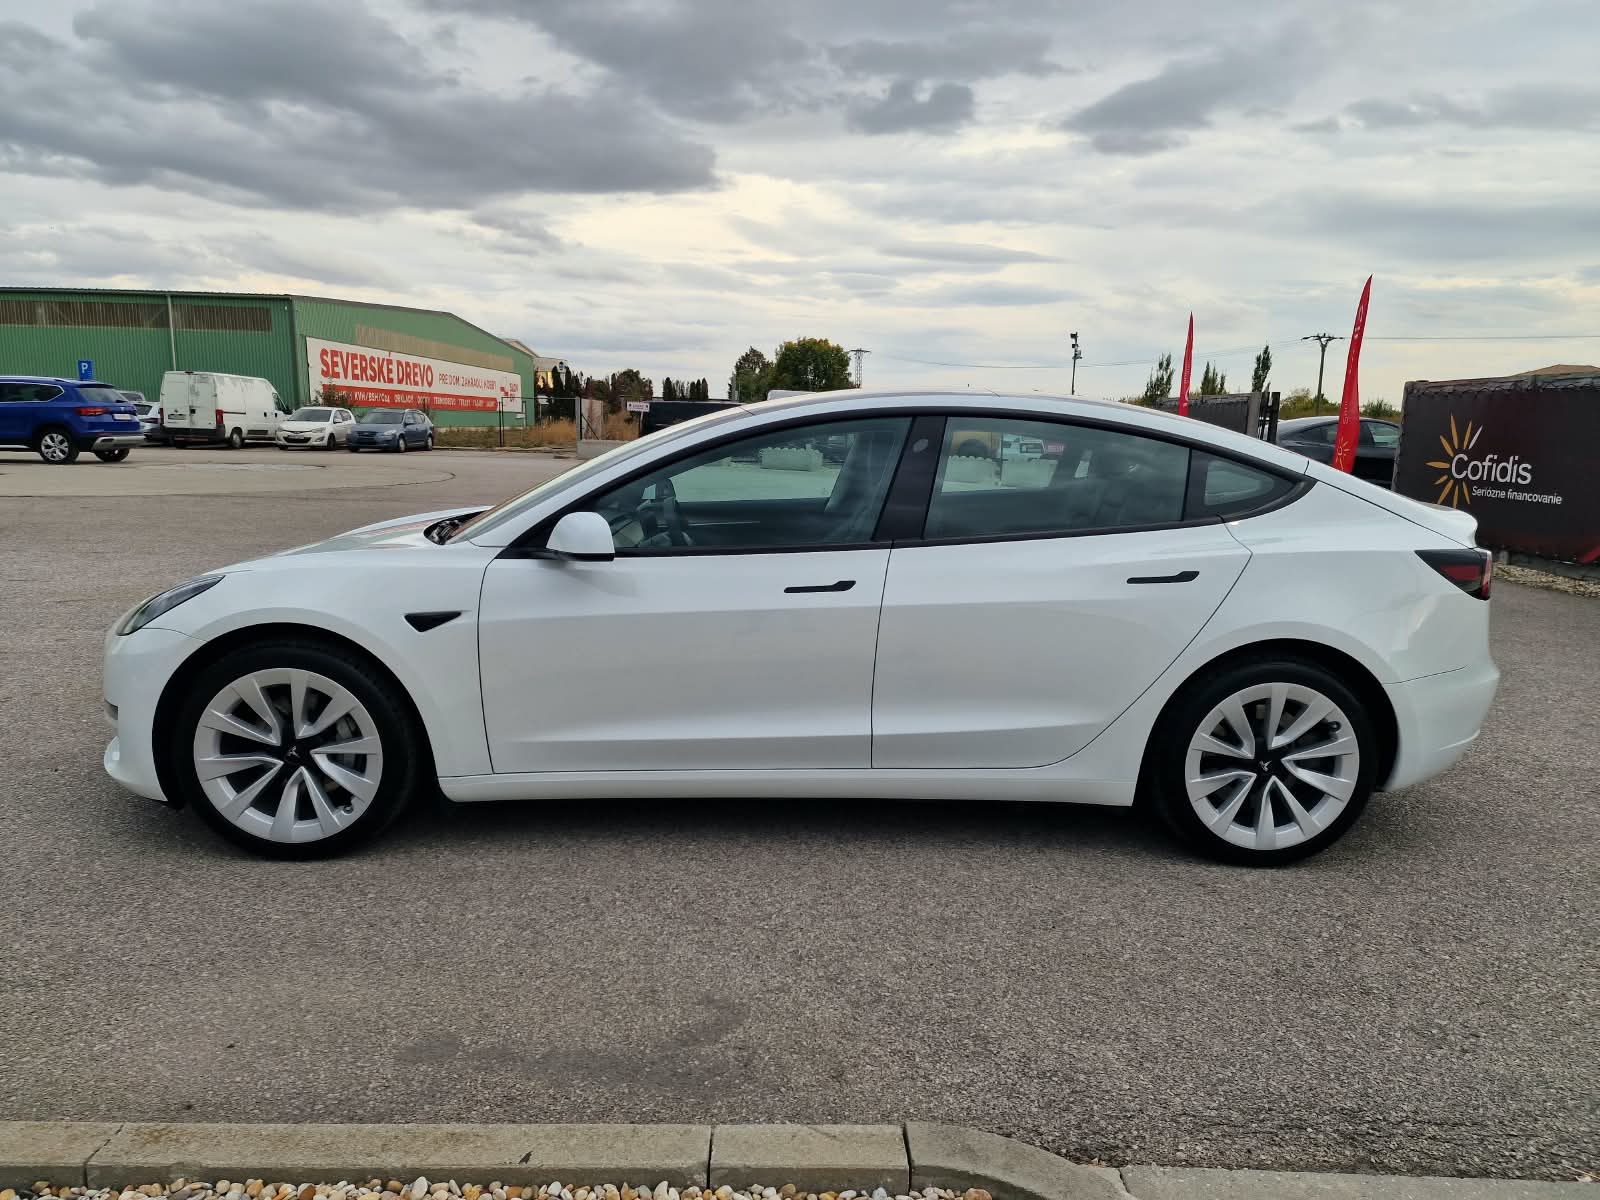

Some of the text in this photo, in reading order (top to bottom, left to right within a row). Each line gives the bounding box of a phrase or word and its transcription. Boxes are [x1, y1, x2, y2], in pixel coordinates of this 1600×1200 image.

[81, 362, 89, 374] P
[320, 351, 434, 388] SEVERSKÉ DREVO
[1451, 453, 1532, 485] Cofidis
[1472, 485, 1562, 505] Seriózne financovanie
